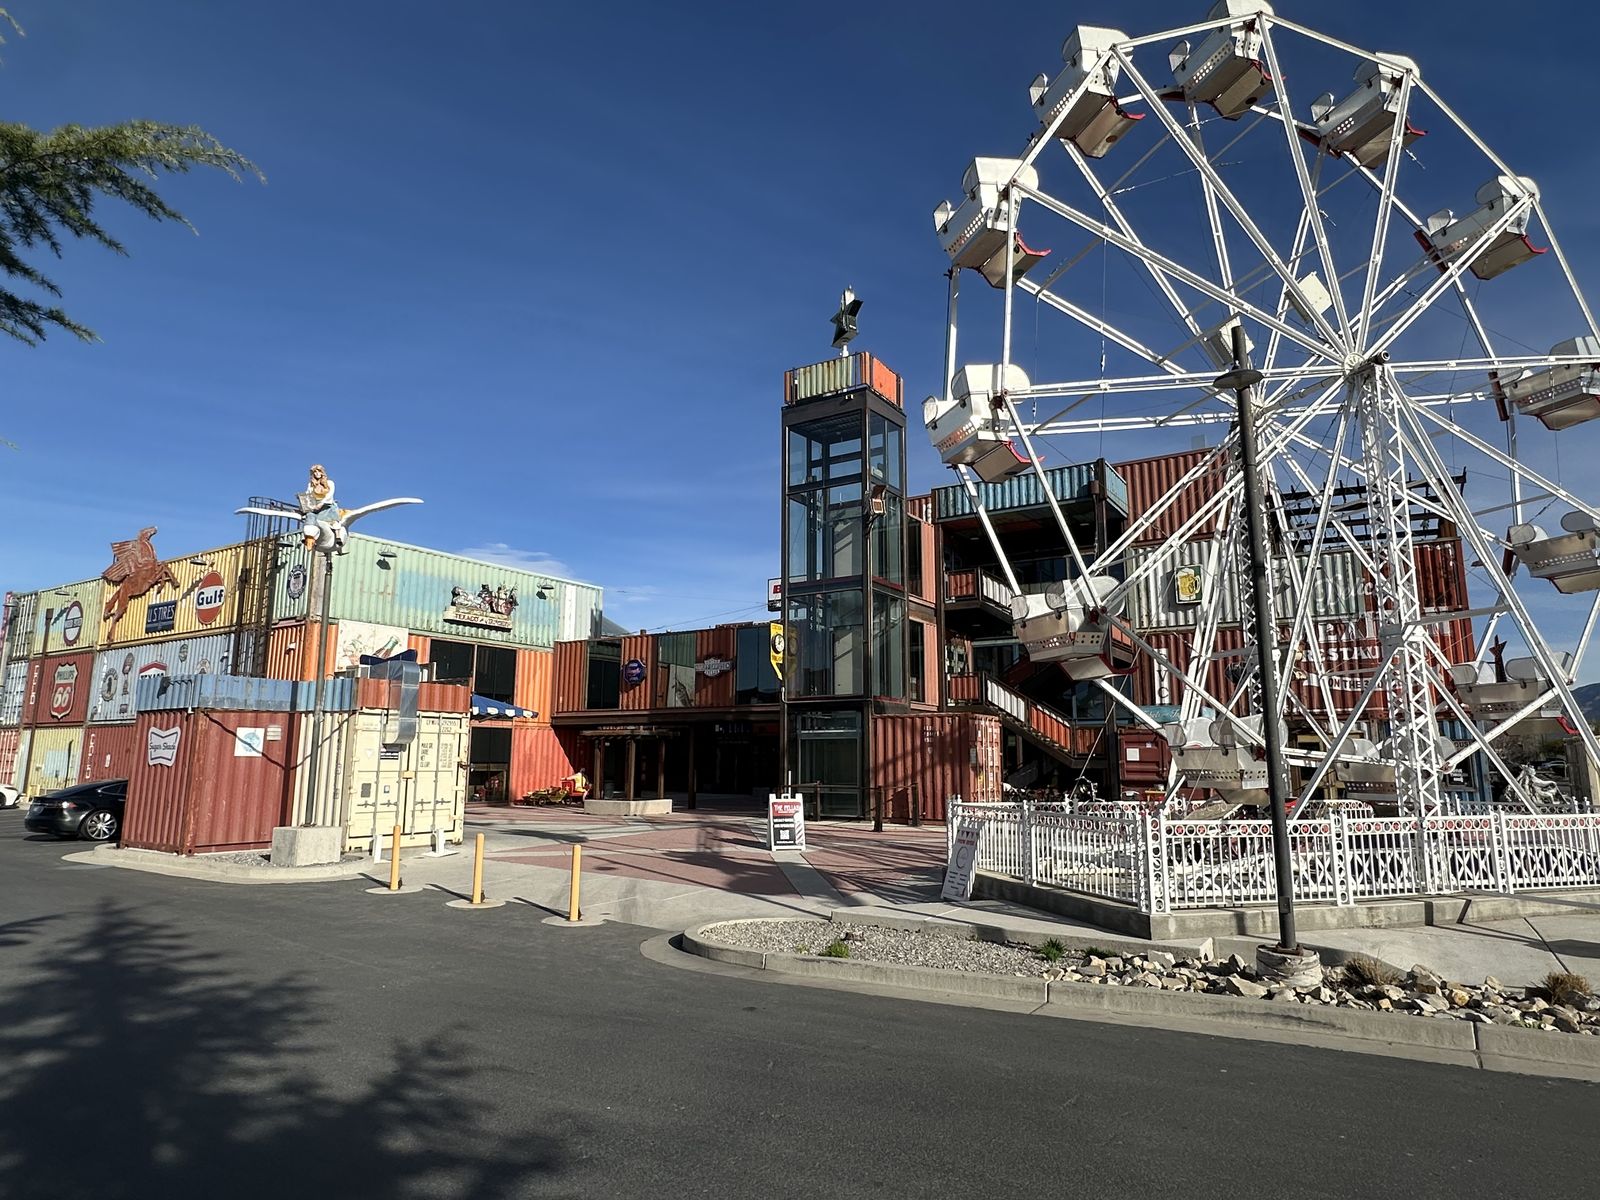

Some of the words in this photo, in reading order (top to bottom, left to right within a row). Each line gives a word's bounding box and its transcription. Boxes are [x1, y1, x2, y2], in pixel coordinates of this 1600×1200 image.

[197, 589, 225, 606] Gulf
[158, 604, 175, 621] TIRES
[1328, 679, 1340, 688] ON
[1343, 680, 1361, 690] THE
[53, 687, 71, 708] 66
[149, 742, 161, 752] Sugar
